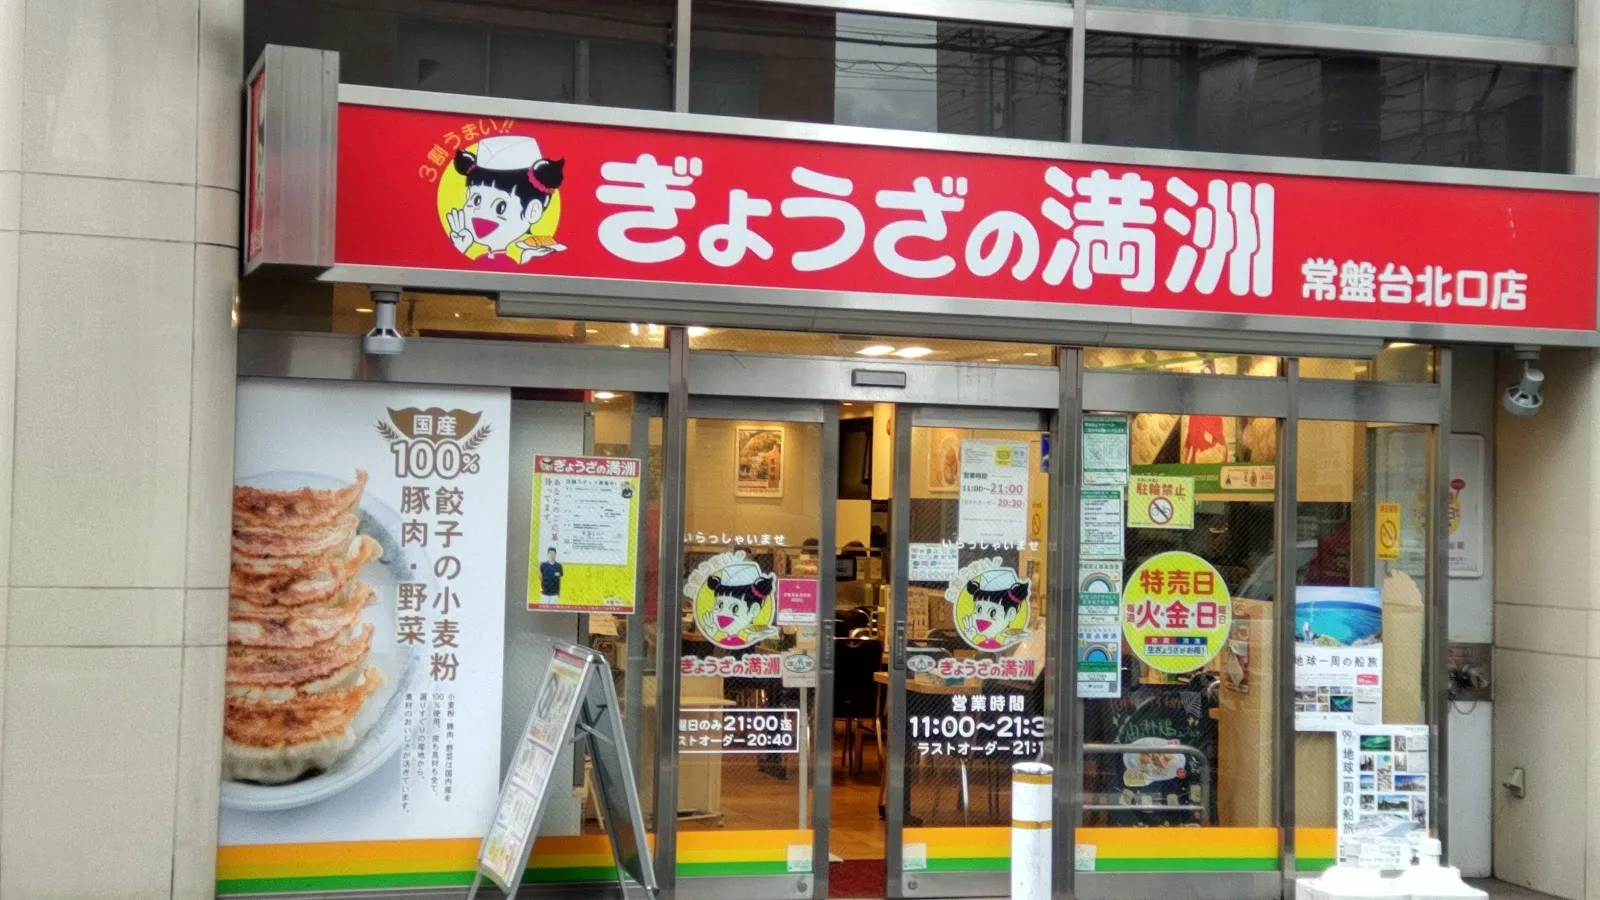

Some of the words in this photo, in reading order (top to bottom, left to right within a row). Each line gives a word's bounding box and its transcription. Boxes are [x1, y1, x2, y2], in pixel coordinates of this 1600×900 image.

[596, 153, 1275, 298] ぎょうざの満洲
[1301, 257, 1528, 311] 常盤台北口店
[413, 414, 457, 436] 国産
[390, 439, 481, 480] 100%
[553, 459, 636, 476] ぎょうざの満洲
[1136, 482, 1187, 497] 駐輪禁止
[683, 532, 786, 546] いらっしゃいませ
[941, 539, 1040, 552] いらっしゃいませ
[397, 486, 430, 646] 豚肉・野菜
[430, 486, 464, 682] 餃子の小麦粉
[1140, 569, 1215, 596] 特売日
[680, 657, 781, 675] ぎょうざの満洲
[940, 659, 1035, 678] ぎょうざの満洲
[1295, 655, 1379, 669] 地球一周の船旅
[951, 694, 1025, 712] 営業時間
[1342, 750, 1355, 835] 地球一周の船旅
